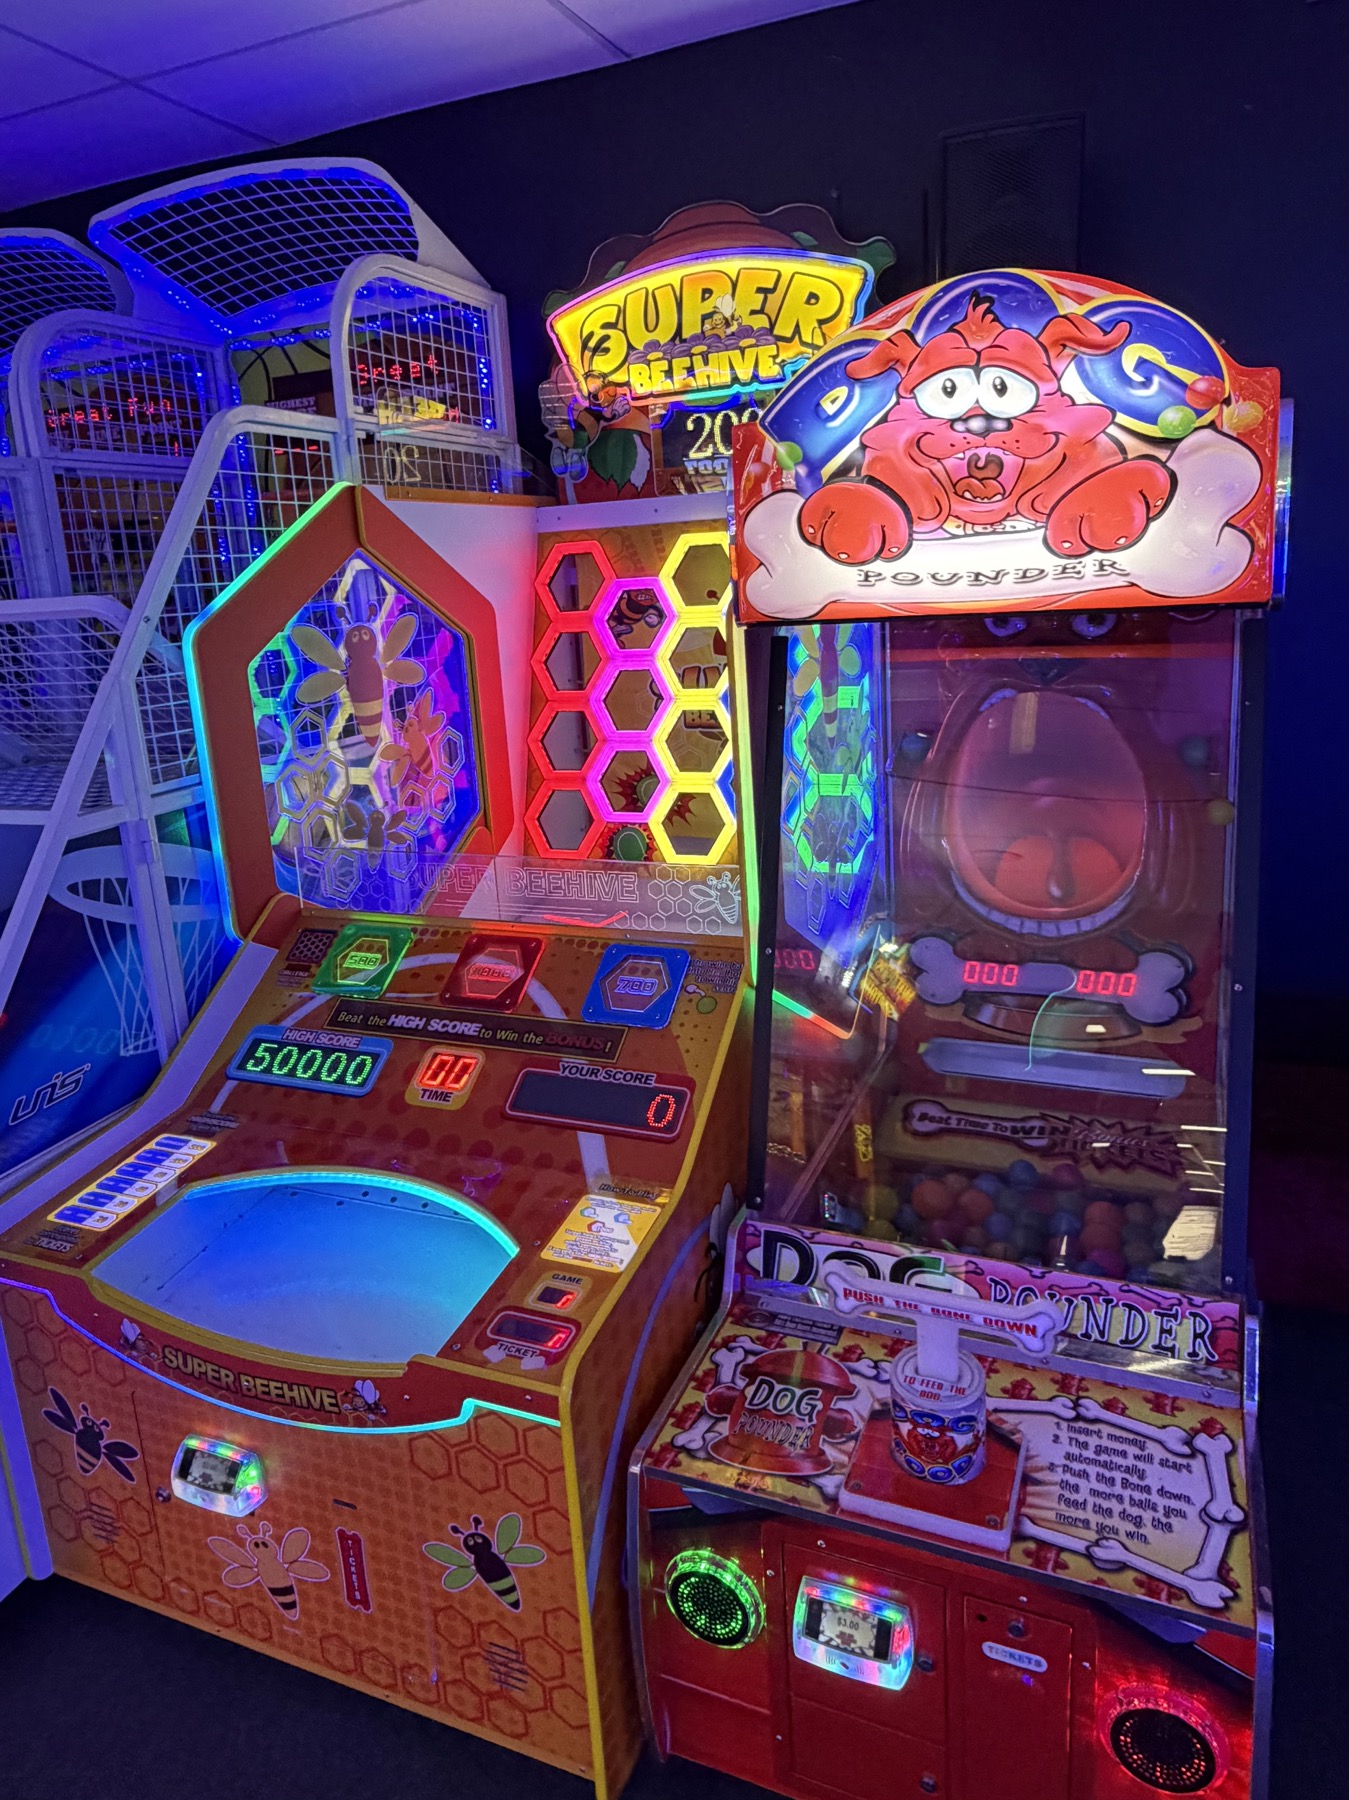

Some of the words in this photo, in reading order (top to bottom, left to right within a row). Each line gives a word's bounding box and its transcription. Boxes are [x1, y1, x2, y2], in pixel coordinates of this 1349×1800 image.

[581, 267, 844, 382] SUPER
[629, 344, 780, 394] BEEHIVE
[686, 408, 766, 459] 20
[857, 558, 1130, 587] POUNDER
[504, 866, 639, 903] BEEHIVE
[616, 977, 658, 994] 700
[963, 960, 1019, 987] 000
[1076, 969, 1137, 997] 000
[282, 1029, 317, 1043] HIGH
[316, 1033, 361, 1049] SCORE
[337, 1011, 364, 1025] Beat
[367, 1013, 387, 1027] the
[387, 1014, 424, 1031] HIGH
[427, 1018, 481, 1037] SCORE
[479, 1027, 493, 1039] to
[496, 1029, 519, 1042] Win
[523, 1032, 544, 1045] the
[246, 1042, 373, 1085] 50000
[560, 1063, 601, 1079] YOUR
[602, 1069, 655, 1086] SCORE
[419, 1088, 453, 1103] TIME
[646, 1093, 677, 1128] 0
[917, 1112, 952, 1126] Beat
[955, 1117, 989, 1130] Time
[1010, 1124, 1071, 1137] WIN
[552, 1273, 583, 1285] GAME
[843, 1287, 884, 1305] PUSH
[892, 1300, 920, 1310] THE
[931, 1306, 973, 1322] BONE
[983, 1317, 1037, 1337] DOWN
[498, 1342, 539, 1358] TICKET
[163, 1346, 238, 1393] SUPER
[240, 1373, 341, 1414] BEEHIVE
[903, 1375, 916, 1386] TO
[920, 1378, 944, 1391] FEED
[950, 1385, 968, 1396] THE
[745, 1376, 822, 1424] DOG
[733, 1412, 814, 1449] POUNDER
[1066, 1423, 1104, 1439] Insert
[1067, 1436, 1089, 1451] The
[1093, 1444, 1129, 1459] game
[1132, 1452, 1155, 1465] will
[1158, 1457, 1194, 1475] start
[1061, 1463, 1091, 1483] Push
[1095, 1471, 1117, 1487] the
[1120, 1477, 1153, 1495] Bone
[1059, 1478, 1081, 1495] the
[1089, 1487, 1125, 1505] more
[1128, 1494, 1160, 1514] balls
[1162, 1504, 1188, 1520] you
[1055, 1511, 1092, 1531] more
[1095, 1521, 1121, 1537] you
[1092, 1502, 1114, 1519] the
[1151, 1516, 1175, 1534] the
[836, 1616, 860, 1632] $3.00
[987, 1644, 1044, 1668] TICKETS
